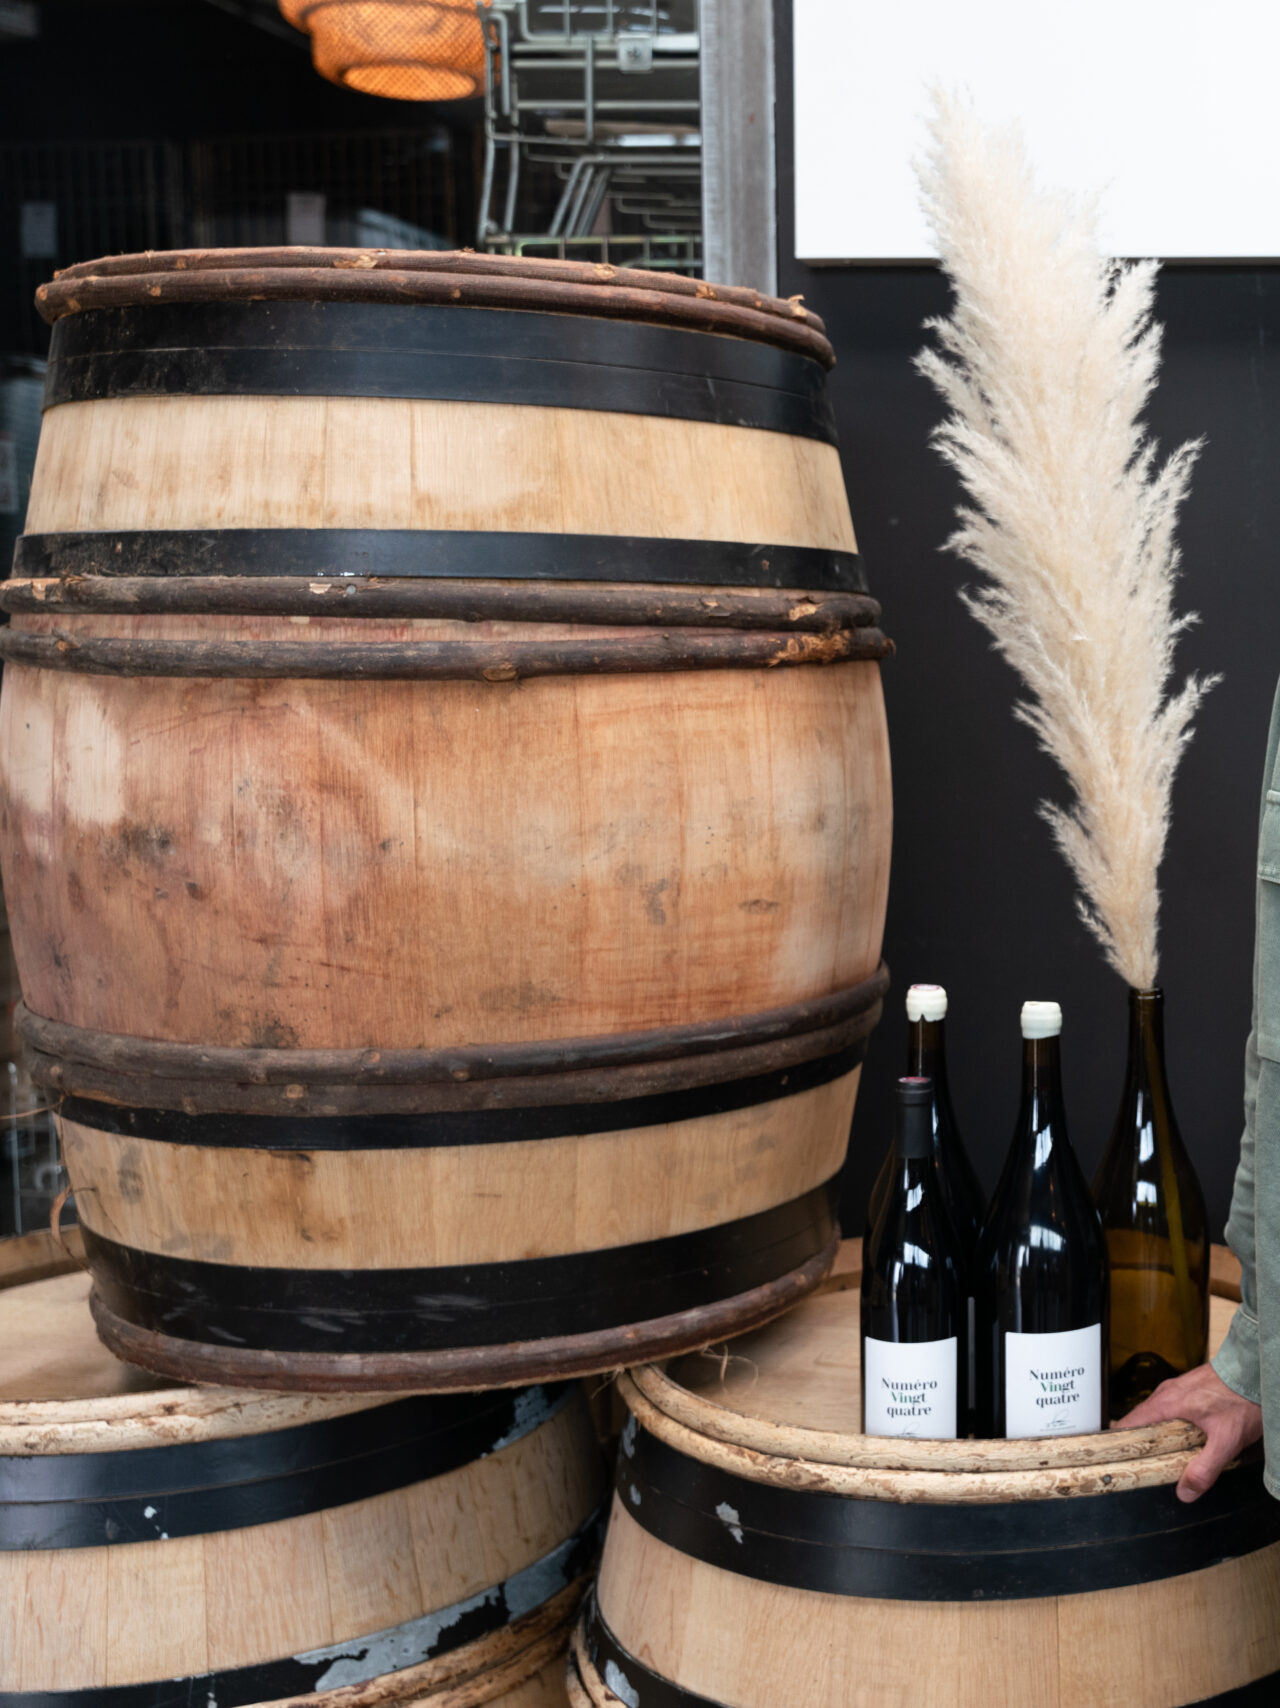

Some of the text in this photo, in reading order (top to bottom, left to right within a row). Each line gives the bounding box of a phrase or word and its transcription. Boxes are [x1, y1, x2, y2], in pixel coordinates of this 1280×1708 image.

[1029, 1366, 1085, 1380] Numéro
[881, 1377, 938, 1391] Numéro
[1040, 1380, 1075, 1394] Vingt
[890, 1391, 925, 1405] Vingt
[1035, 1393, 1080, 1408] quatre
[886, 1406, 932, 1418] quatre
